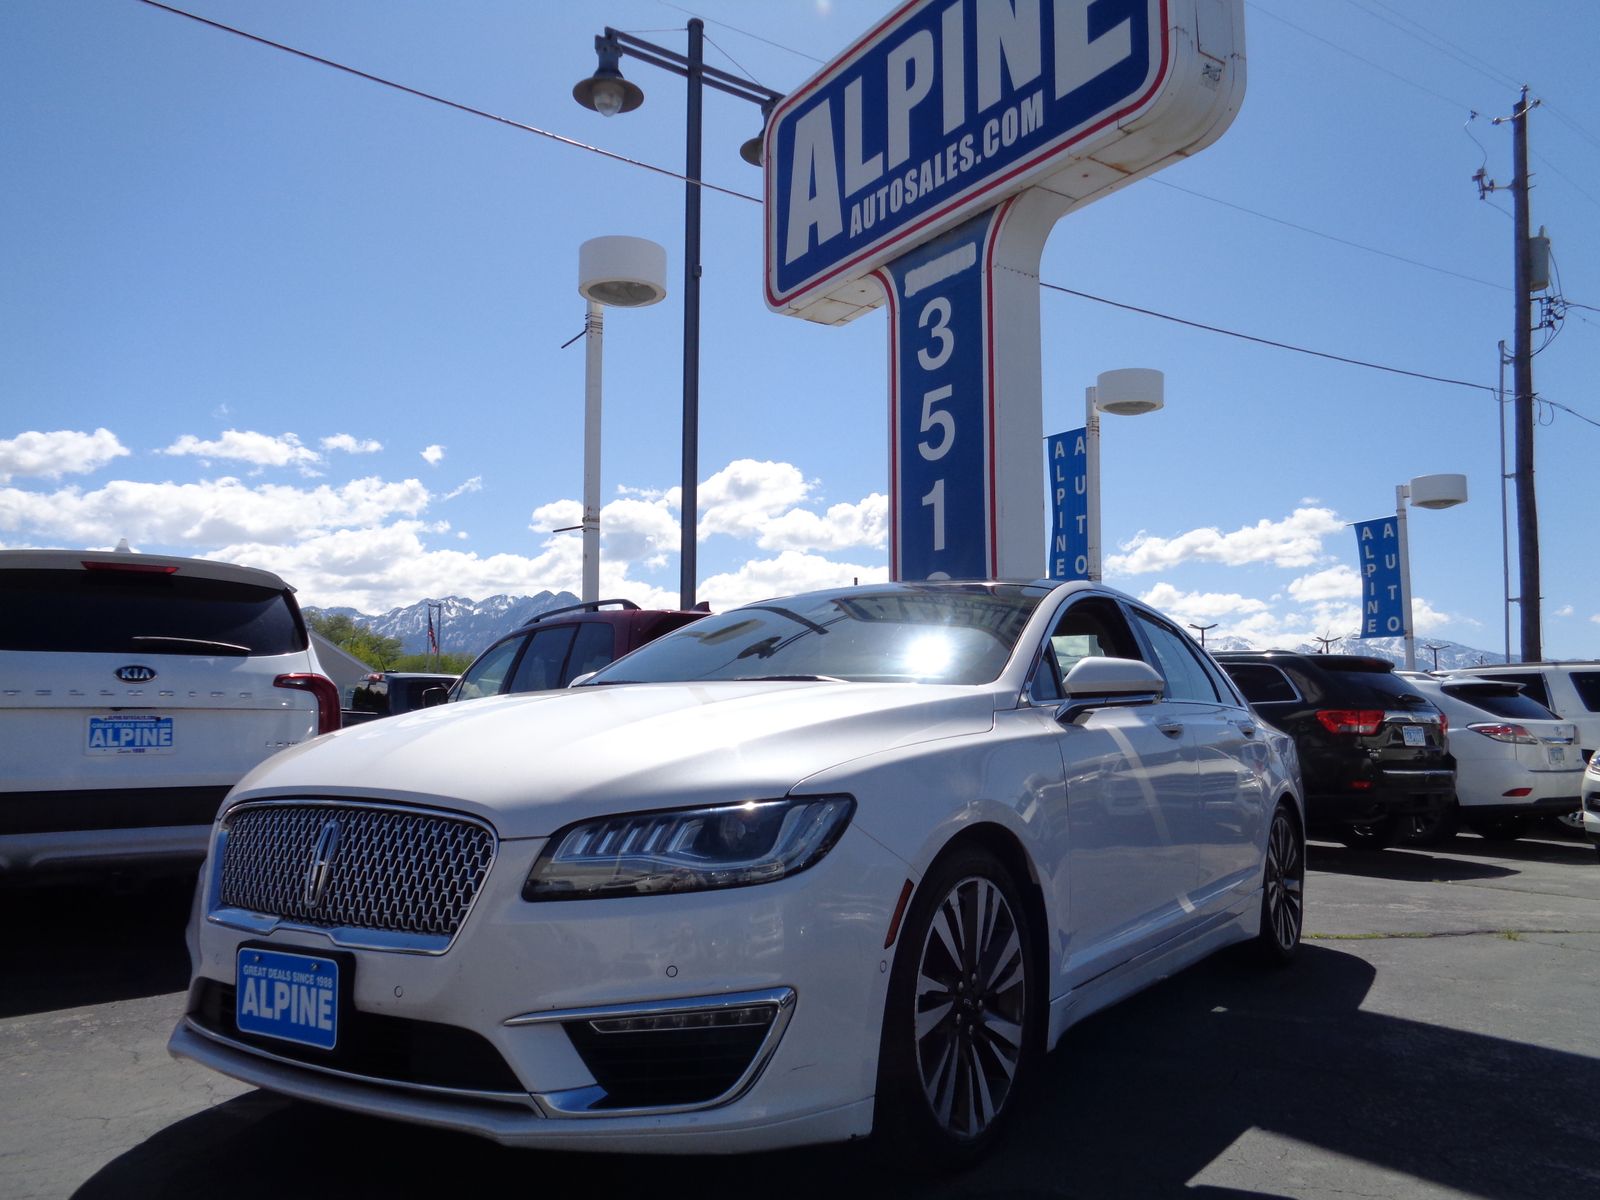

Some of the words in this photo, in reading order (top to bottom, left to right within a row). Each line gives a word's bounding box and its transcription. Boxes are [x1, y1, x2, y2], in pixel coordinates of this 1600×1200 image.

[785, 0, 1132, 265] ALPINE
[849, 89, 1044, 239] AUTOSALES.COM
[1054, 440, 1066, 576] ALPINE
[1074, 436, 1087, 575] AUTO
[1361, 526, 1378, 633] ALPINE
[1383, 523, 1400, 632] AUTO
[121, 668, 151, 679] KIA
[90, 728, 172, 747] ALPINE
[241, 977, 334, 1032] ALPINE
[243, 964, 267, 978] GREAT
[267, 968, 292, 982] DEALS
[292, 971, 315, 986] SINCE
